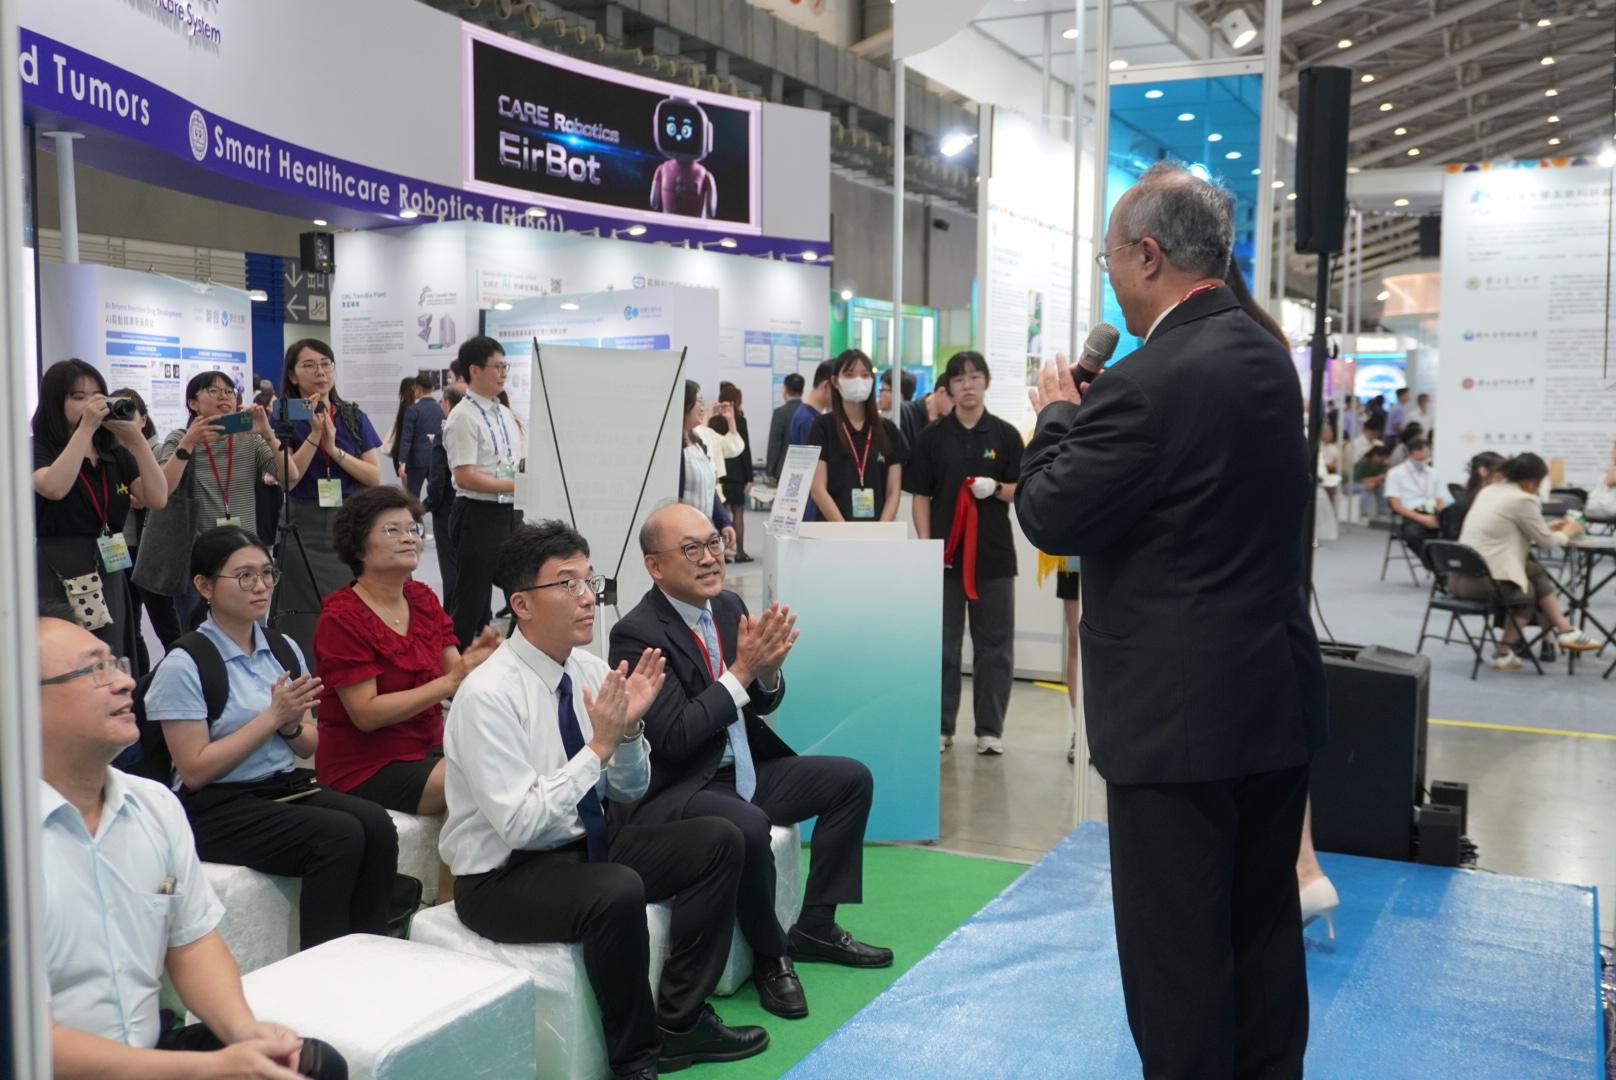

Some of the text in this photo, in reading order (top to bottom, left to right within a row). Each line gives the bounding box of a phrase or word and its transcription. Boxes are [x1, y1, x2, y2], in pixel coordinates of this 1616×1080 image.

[187, 3, 221, 44] System
[53, 54, 150, 126] Tumors
[498, 95, 621, 144] CARE Robotics
[214, 125, 271, 174] Smart
[279, 150, 390, 205] Healthcare
[399, 183, 484, 222] Robotics
[498, 131, 601, 185] EirBot
[501, 279, 511, 289] AI
[105, 301, 127, 312] AI-Driven
[127, 303, 147, 314] Precision
[147, 306, 157, 317] Drug
[157, 308, 183, 319] Development
